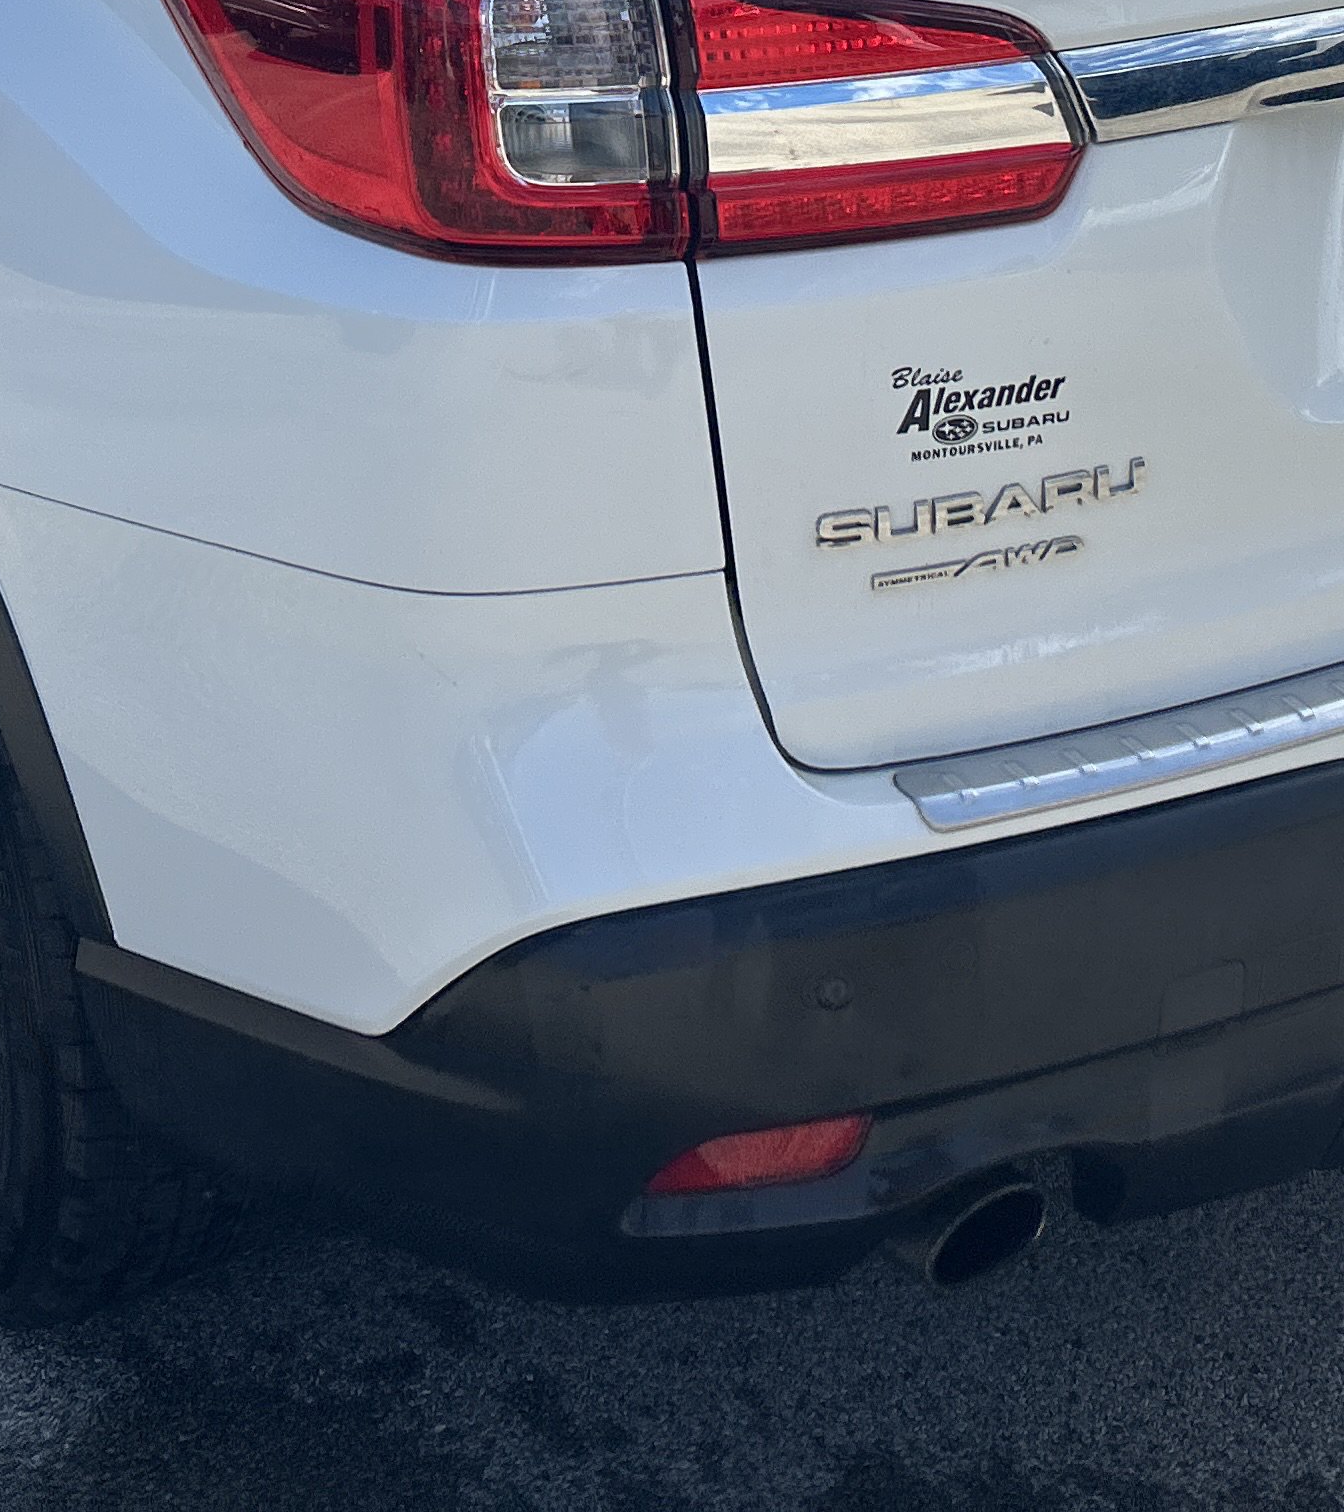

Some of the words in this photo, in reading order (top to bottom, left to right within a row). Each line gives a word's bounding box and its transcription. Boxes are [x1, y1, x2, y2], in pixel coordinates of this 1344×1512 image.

[891, 367, 963, 389] Blaise
[896, 374, 1066, 434] Alexander
[982, 410, 1070, 434] SUBARU
[911, 437, 1024, 462] MONTOURSVILLE,
[1027, 434, 1044, 446] PA
[815, 456, 1147, 548] SUBARU
[952, 534, 1085, 578] AWD
